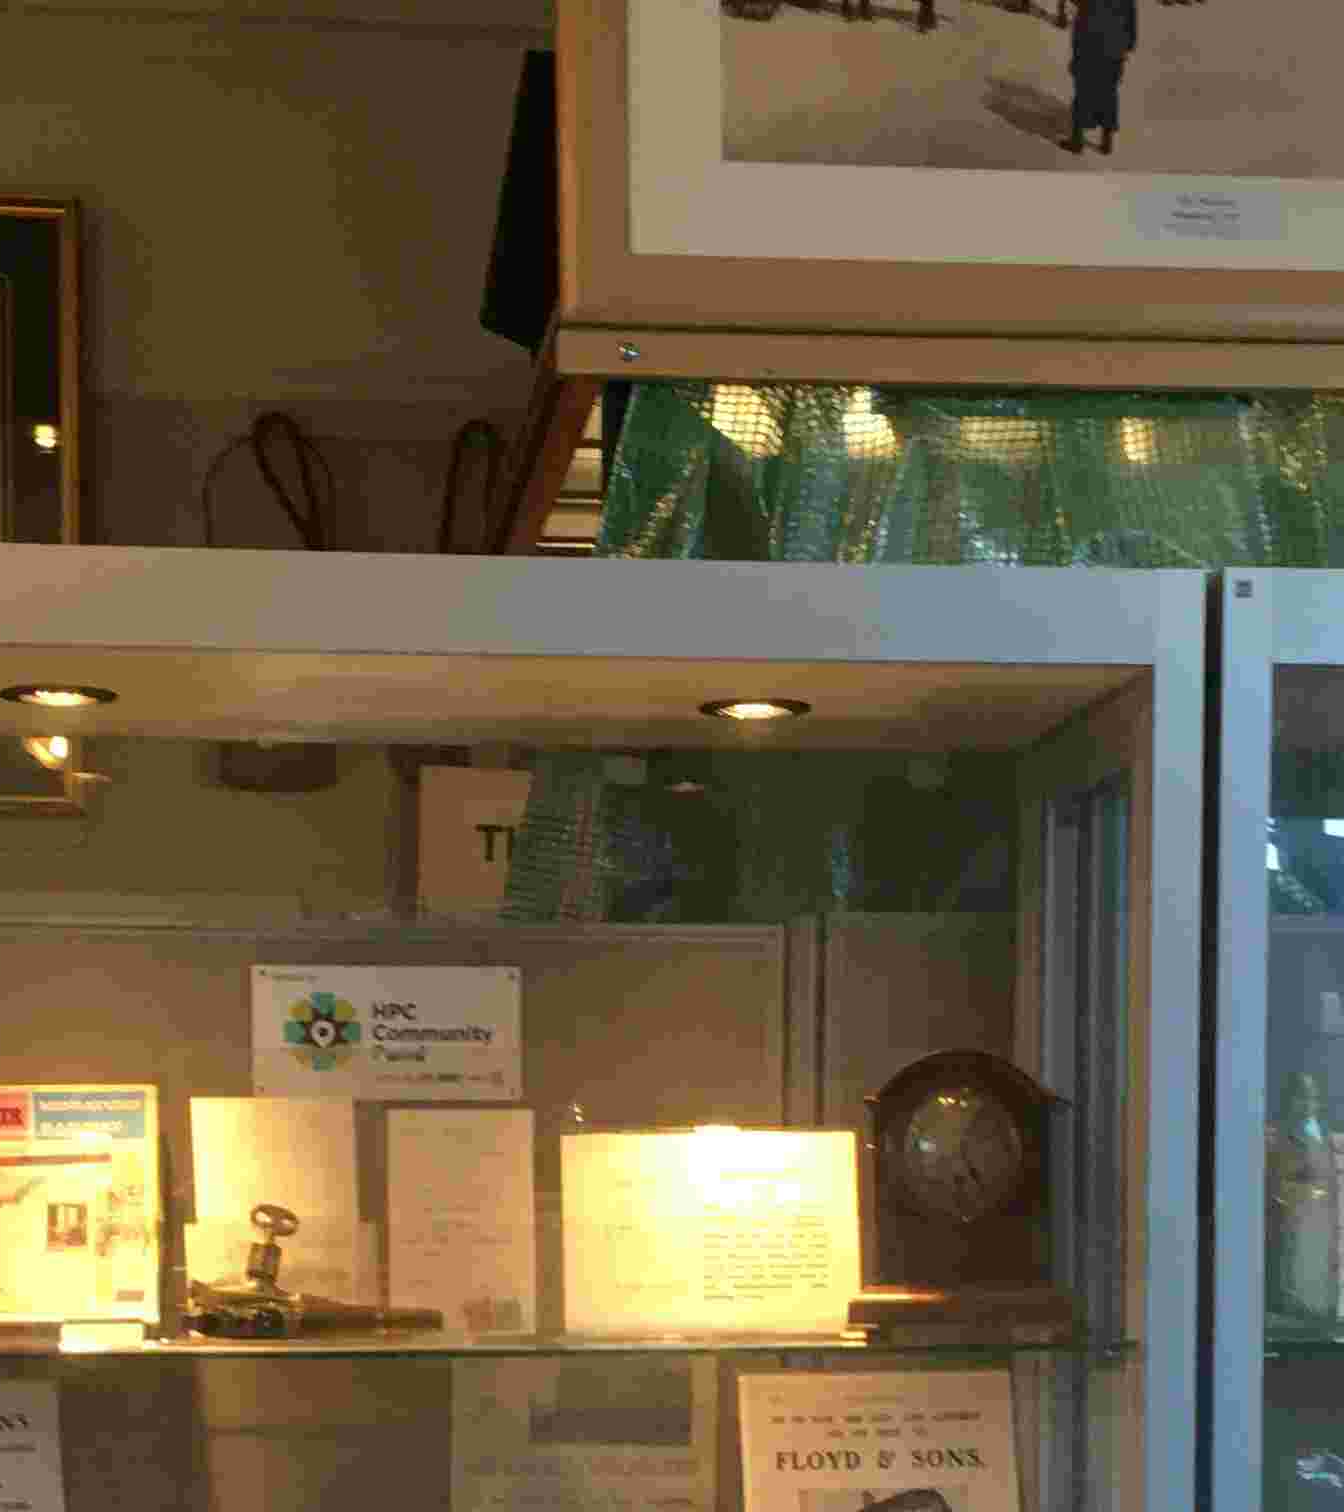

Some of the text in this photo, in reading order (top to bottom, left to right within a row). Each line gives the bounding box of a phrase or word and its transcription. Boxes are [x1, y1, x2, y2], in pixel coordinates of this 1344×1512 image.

[370, 1000, 417, 1022] HPC
[370, 1023, 496, 1047] Community
[774, 1449, 861, 1472] FLOYD
